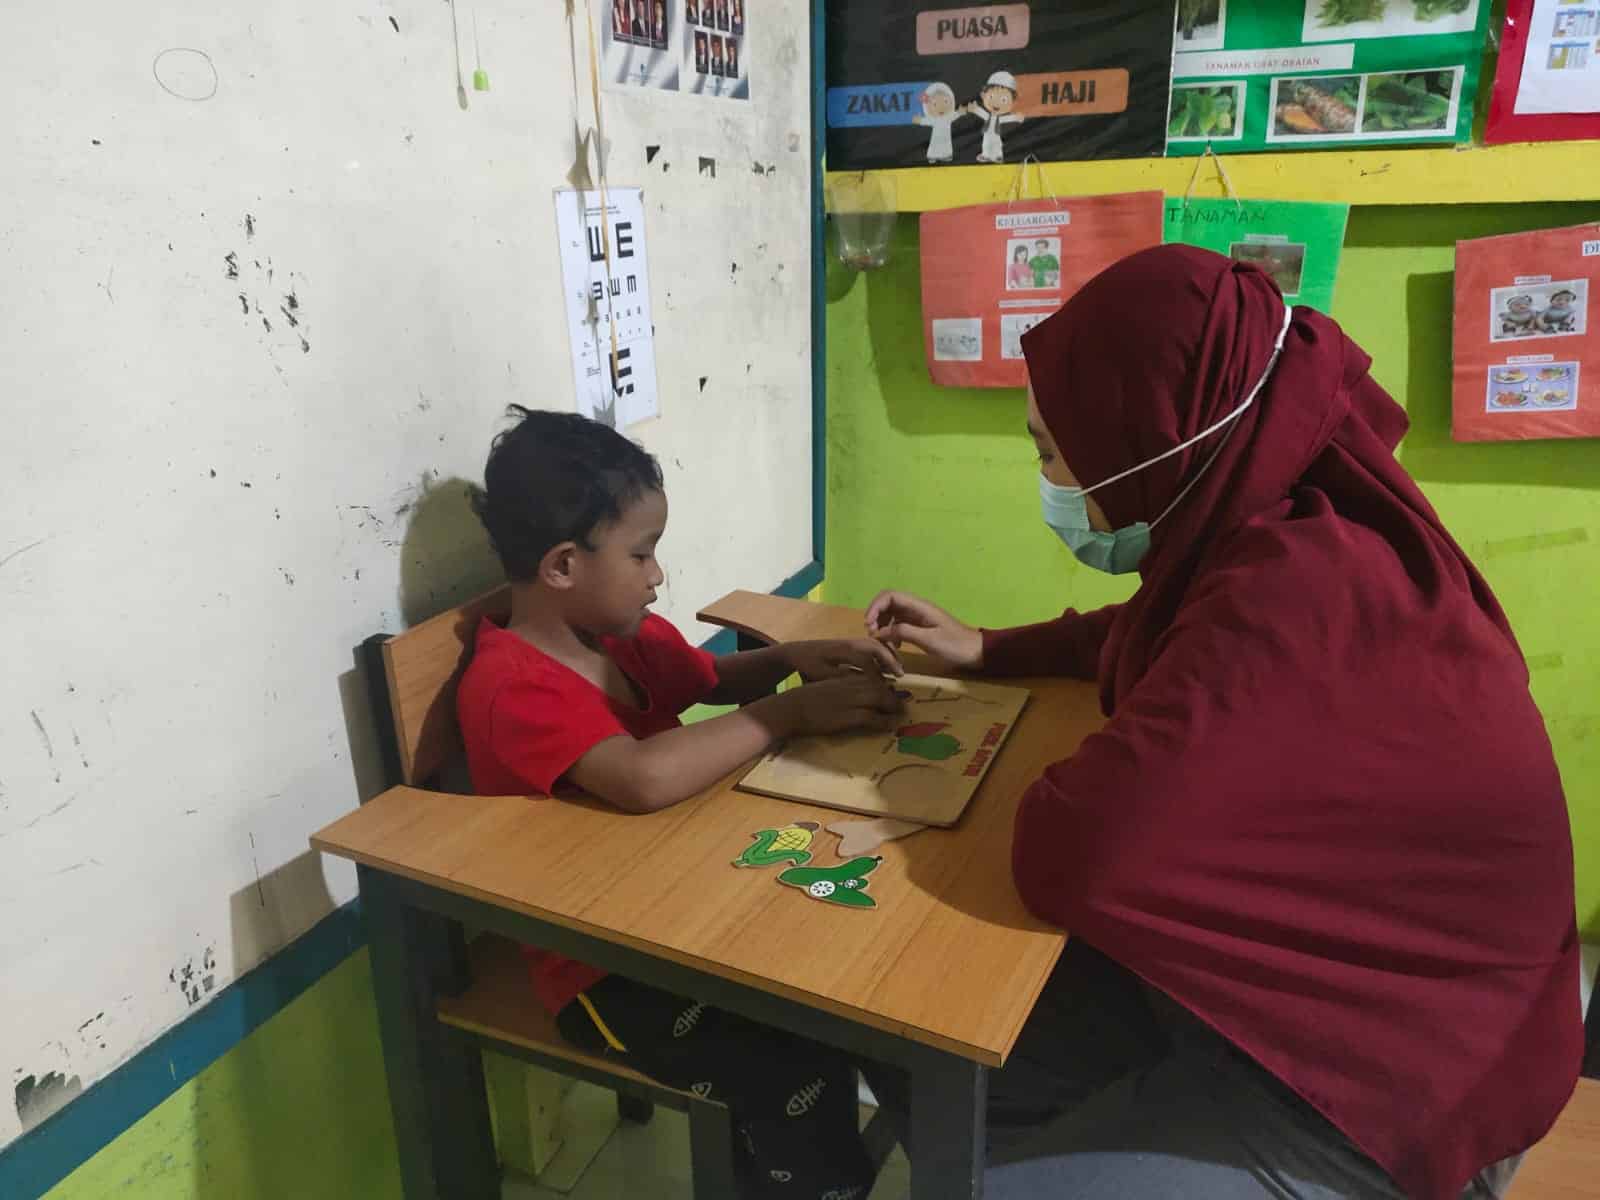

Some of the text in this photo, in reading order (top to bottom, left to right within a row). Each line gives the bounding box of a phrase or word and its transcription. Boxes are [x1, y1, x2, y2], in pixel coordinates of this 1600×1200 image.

[936, 15, 1009, 41] PUASA
[847, 91, 913, 115] ZAKAT
[1040, 79, 1096, 105] HAJI
[1168, 207, 1265, 224] TANAMAN
